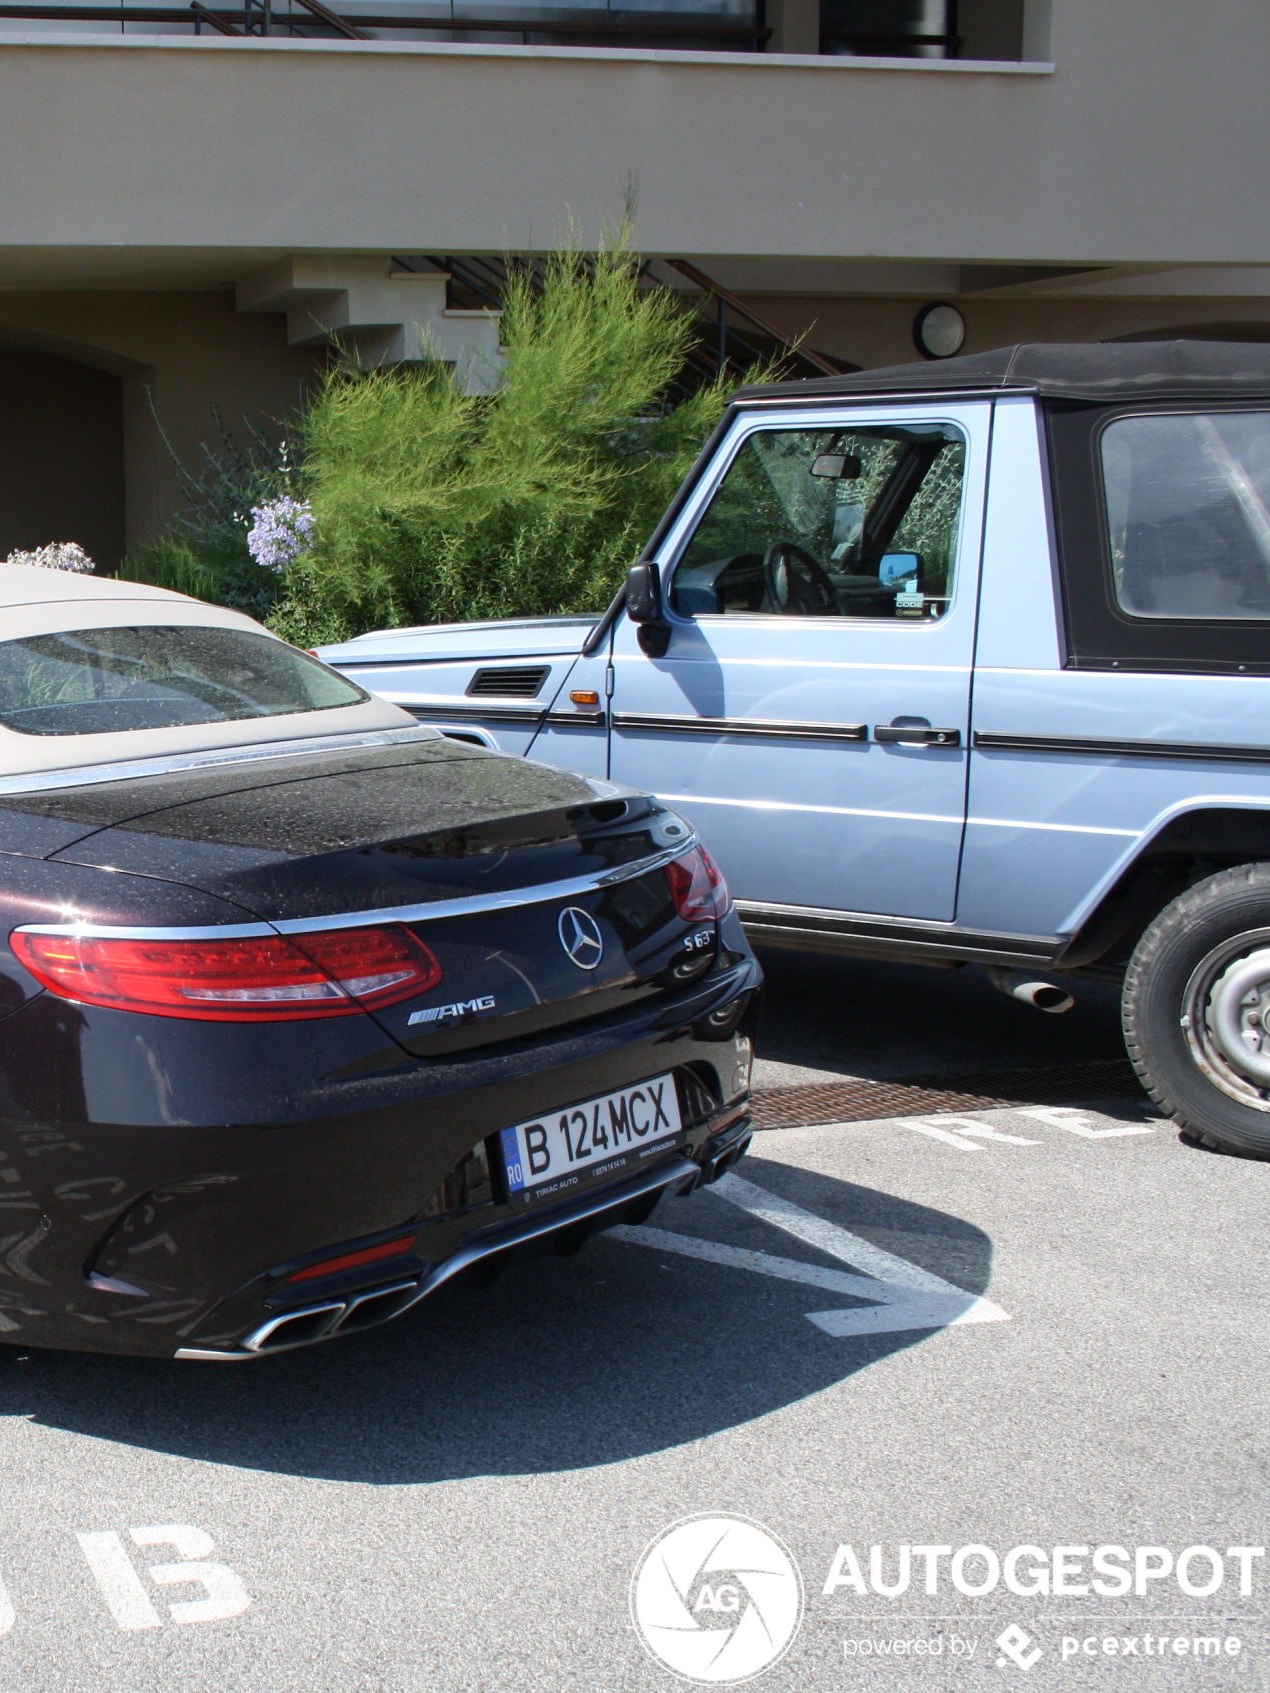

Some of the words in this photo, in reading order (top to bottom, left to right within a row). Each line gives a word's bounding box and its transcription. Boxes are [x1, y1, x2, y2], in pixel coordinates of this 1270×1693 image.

[683, 936, 693, 951] S
[693, 930, 711, 948] 63
[438, 995, 496, 1020] AMG
[524, 1124, 550, 1175] B
[507, 1165, 522, 1185] RO
[535, 1184, 559, 1199] TIRIAC
[559, 1177, 578, 1190] AUTO
